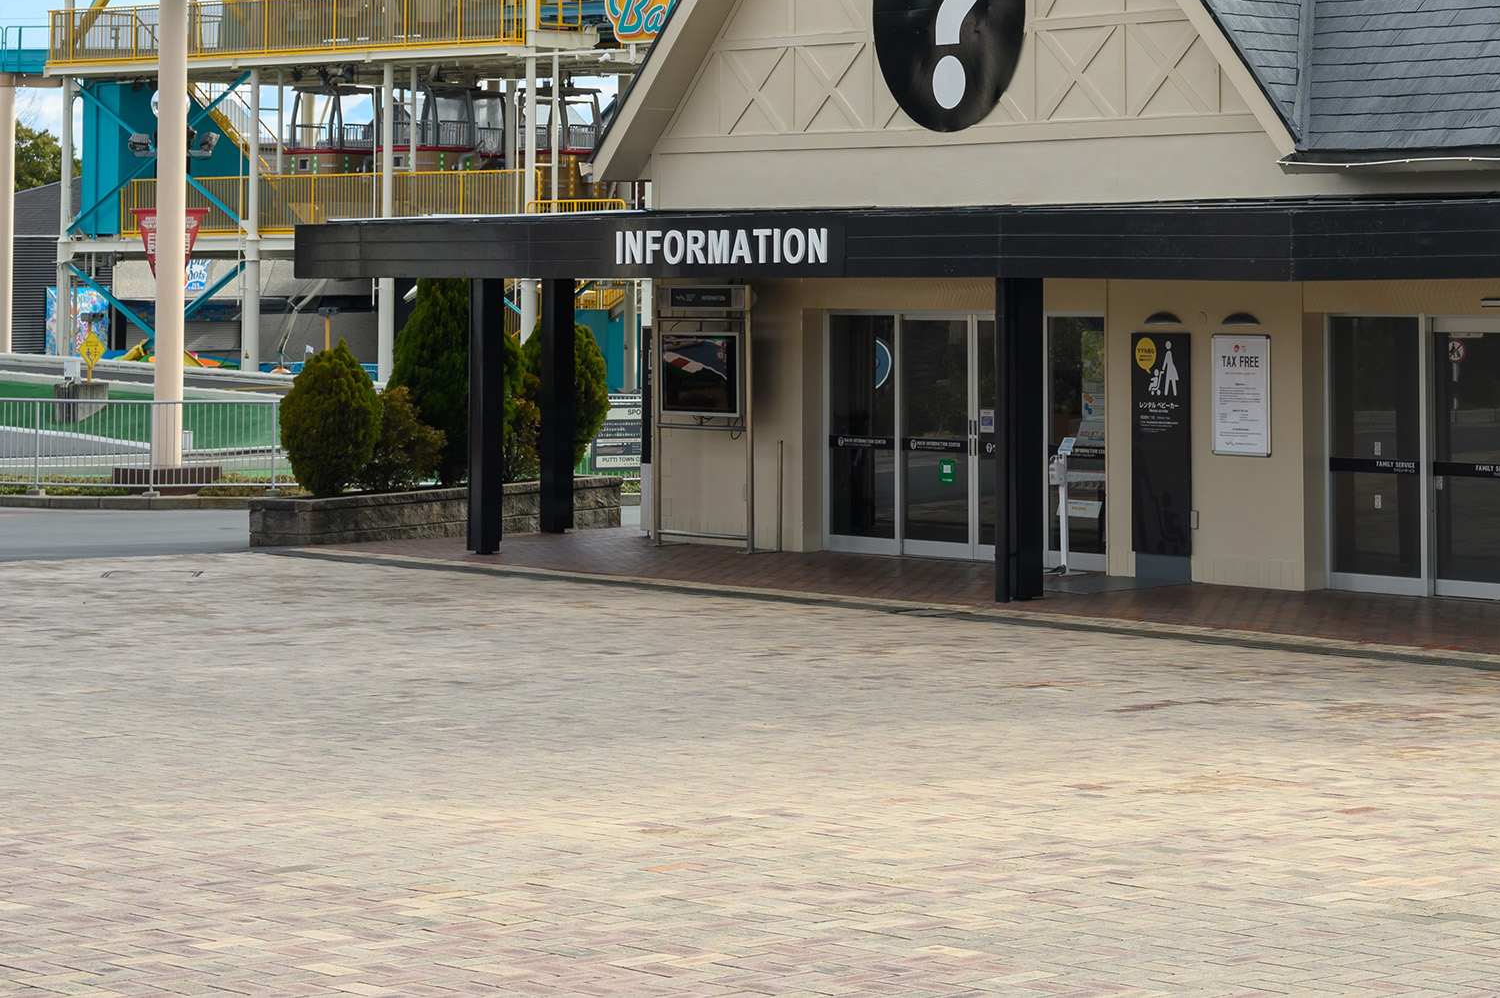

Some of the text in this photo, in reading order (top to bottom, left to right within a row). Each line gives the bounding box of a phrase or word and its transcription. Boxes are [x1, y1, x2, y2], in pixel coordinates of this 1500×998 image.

[615, 228, 828, 265] INFORMATION
[1221, 355, 1259, 368] TAX FREE
[1376, 460, 1415, 469] FAMILY SERVICE
[1475, 464, 1494, 472] FAMILY
